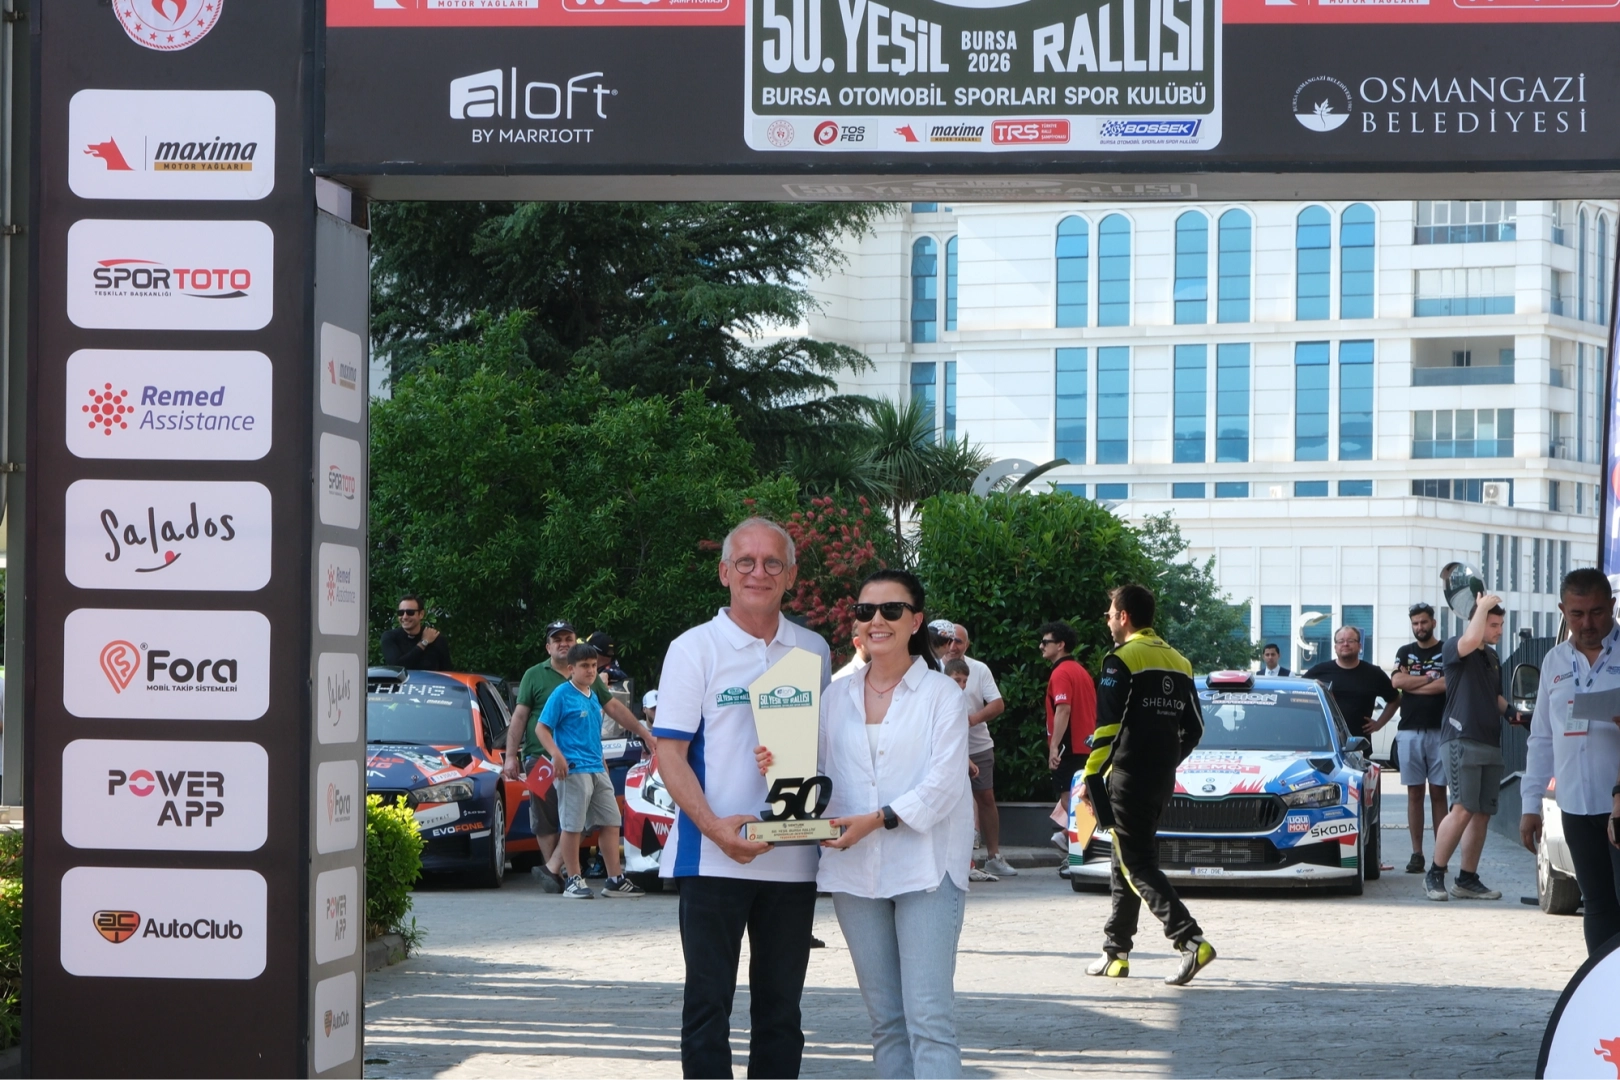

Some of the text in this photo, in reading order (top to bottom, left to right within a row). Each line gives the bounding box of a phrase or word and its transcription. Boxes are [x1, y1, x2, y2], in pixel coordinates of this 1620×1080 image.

[961, 29, 1017, 51] BURSA
[967, 52, 1011, 73] 2026
[450, 67, 610, 120] aloft
[762, 82, 1207, 107] BURSA OTOMOBİL SPORLARI SPOR KULÜBÜ
[1359, 73, 1587, 103] OSMANGAZİ
[841, 126, 866, 134] TOS
[930, 123, 984, 137] maxima
[1123, 124, 1192, 134] BOSSEK
[1362, 108, 1588, 134] BELEDİYESİ
[471, 128, 594, 144] BY MARRIOTT
[840, 134, 864, 142] FED
[995, 124, 1040, 141] TRS
[155, 138, 257, 162] maxima
[163, 163, 196, 171] MOTOR
[140, 385, 226, 407] Remed
[139, 410, 255, 431] Assistance
[100, 501, 236, 562] Salados
[147, 650, 238, 684] Fora
[146, 684, 171, 692] MOBİL
[172, 684, 194, 692] TAKİP
[108, 769, 225, 798] POWER
[760, 775, 833, 822] 50
[157, 800, 225, 827] APP
[1289, 816, 1309, 824] LIQUI
[432, 821, 485, 837] EVOFONE
[1289, 823, 1310, 832] MOLY
[142, 918, 243, 939] AutoClub
